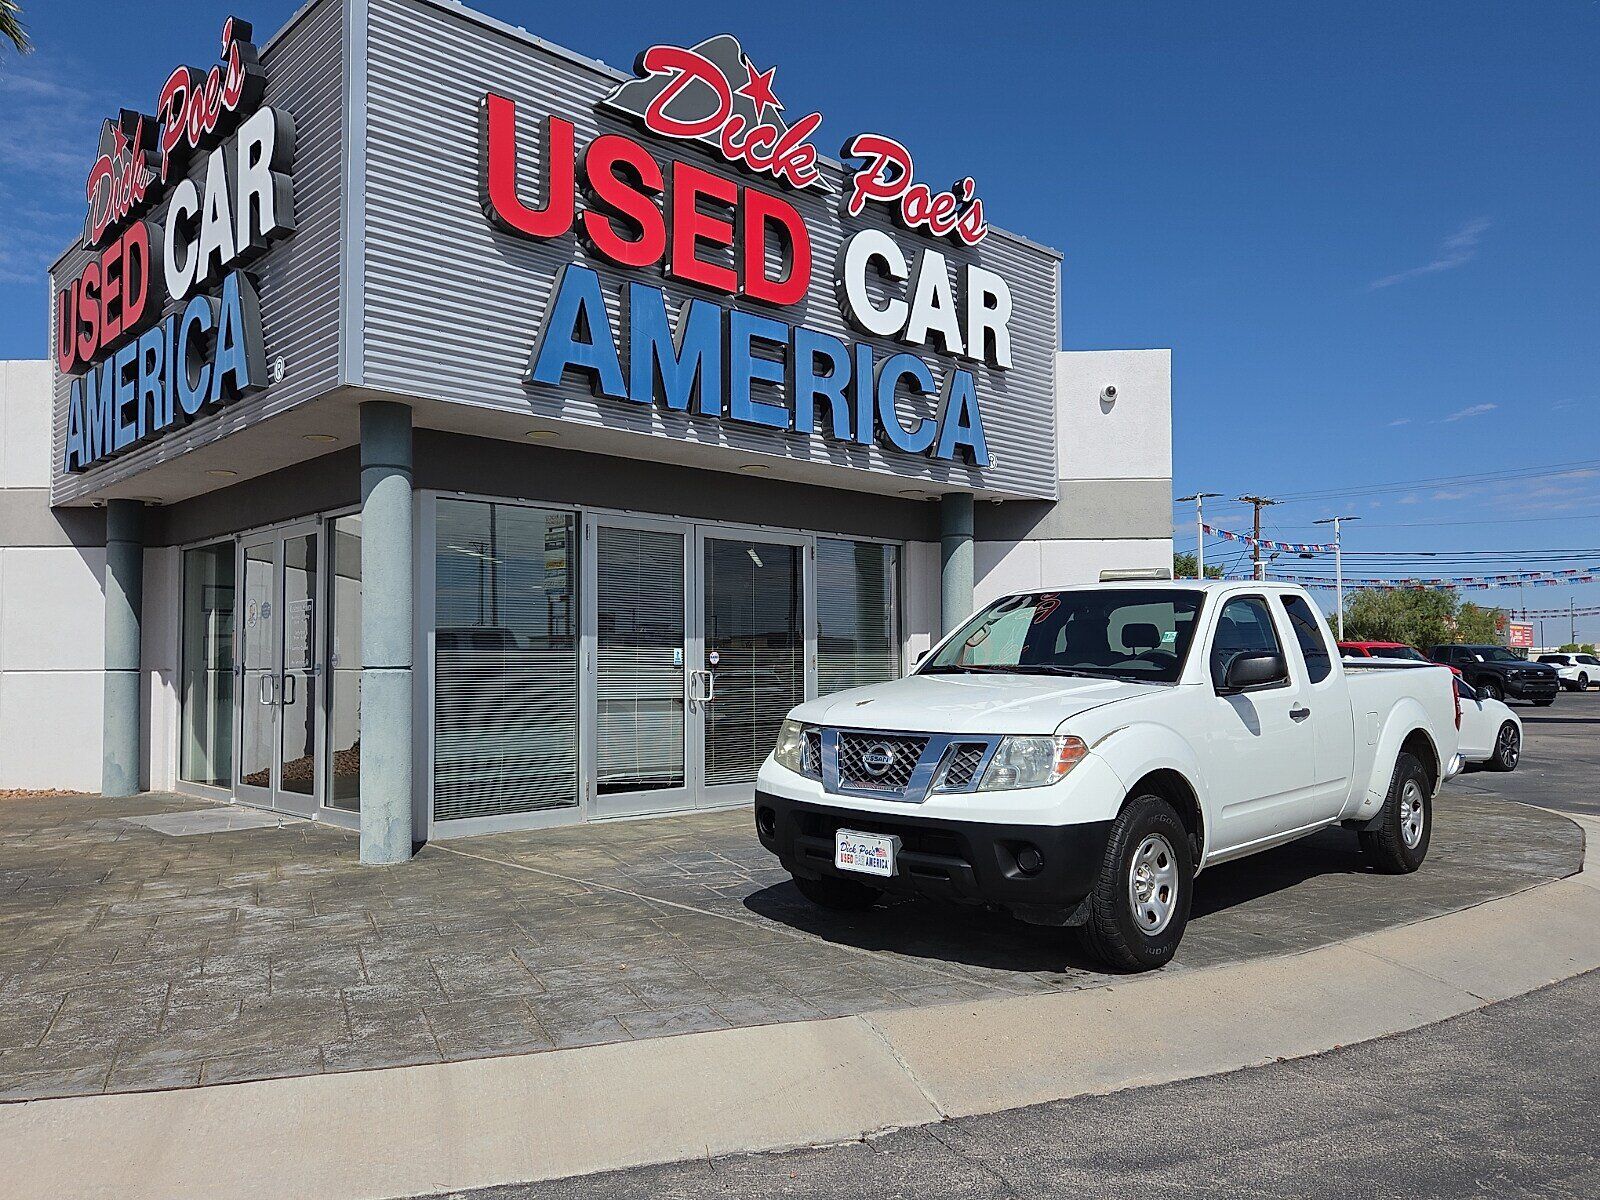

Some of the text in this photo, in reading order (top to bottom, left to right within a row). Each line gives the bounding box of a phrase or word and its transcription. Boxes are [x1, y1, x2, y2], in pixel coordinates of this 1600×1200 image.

[88, 15, 246, 243] Dick Poe's
[487, 91, 1014, 370] USED CAR
[642, 44, 988, 247] Dick Poe's
[57, 105, 278, 375] USED CAR
[63, 270, 249, 474] AMERICA
[531, 263, 991, 467] AMERICA
[840, 841, 857, 854] Dick
[840, 852, 854, 864] USED
[865, 856, 889, 870] AMERICA
